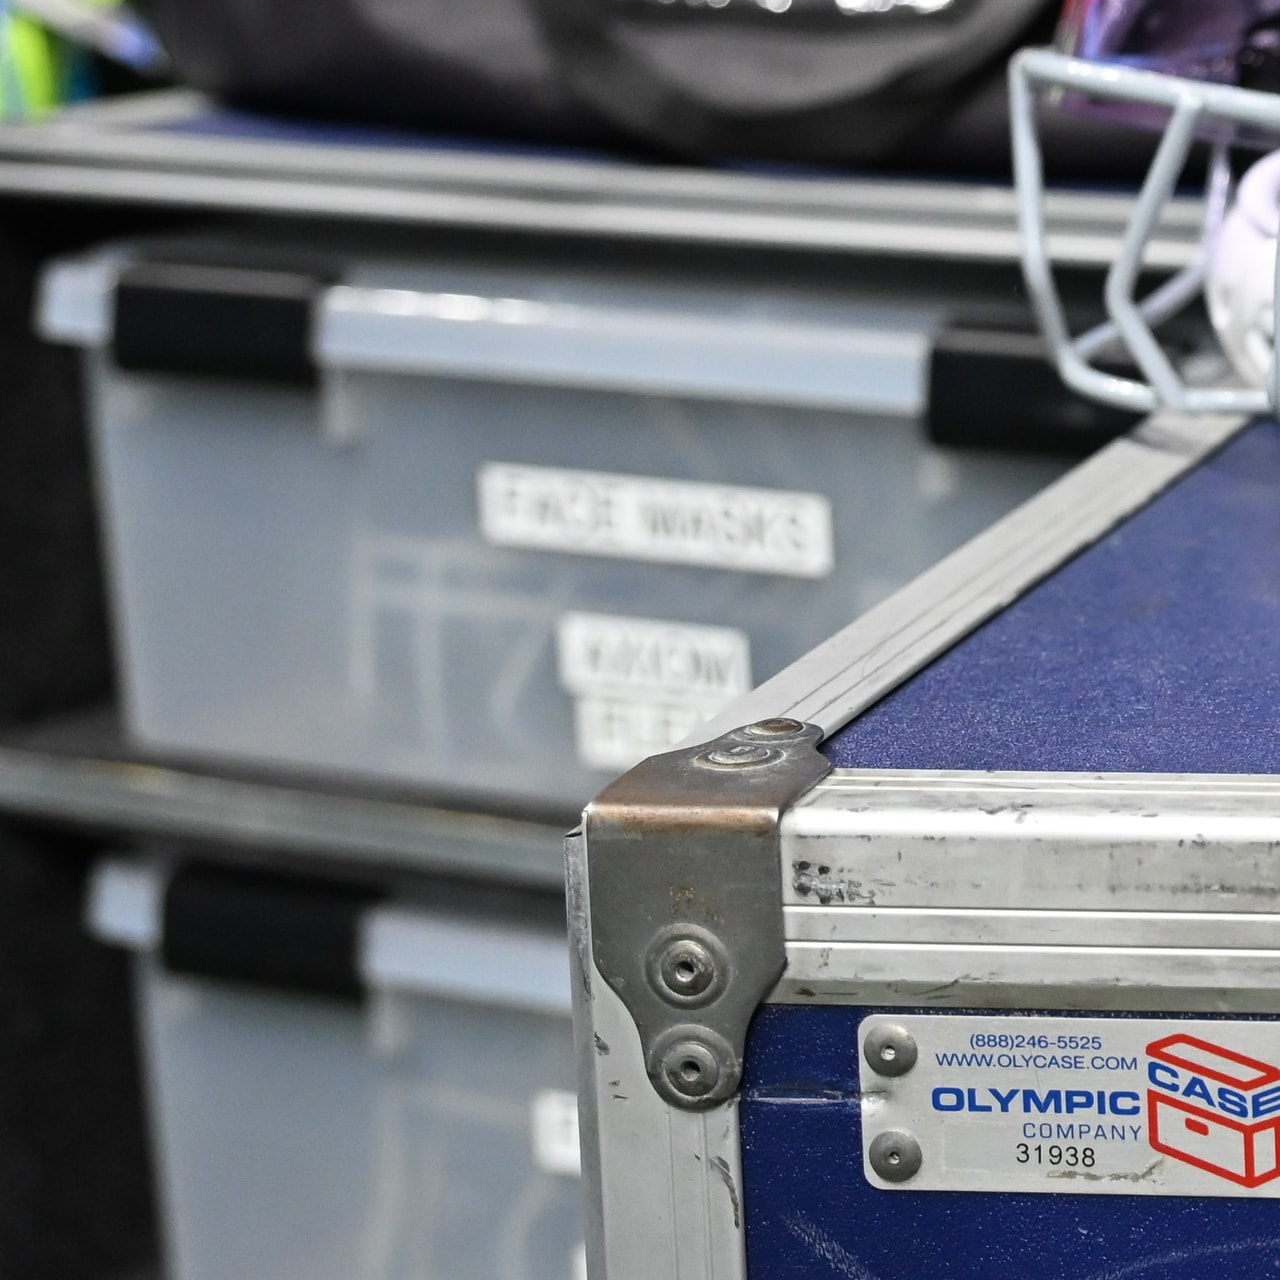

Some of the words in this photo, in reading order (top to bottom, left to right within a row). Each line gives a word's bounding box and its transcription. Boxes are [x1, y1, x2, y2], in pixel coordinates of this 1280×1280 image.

[970, 1033, 1102, 1051] (888)246-5525
[935, 1053, 1138, 1070] WWW.OLYCASE.COM
[931, 1086, 1141, 1116] OLYMPIC
[1023, 1122, 1142, 1141] COMPANY
[1016, 1143, 1096, 1168] 31938
